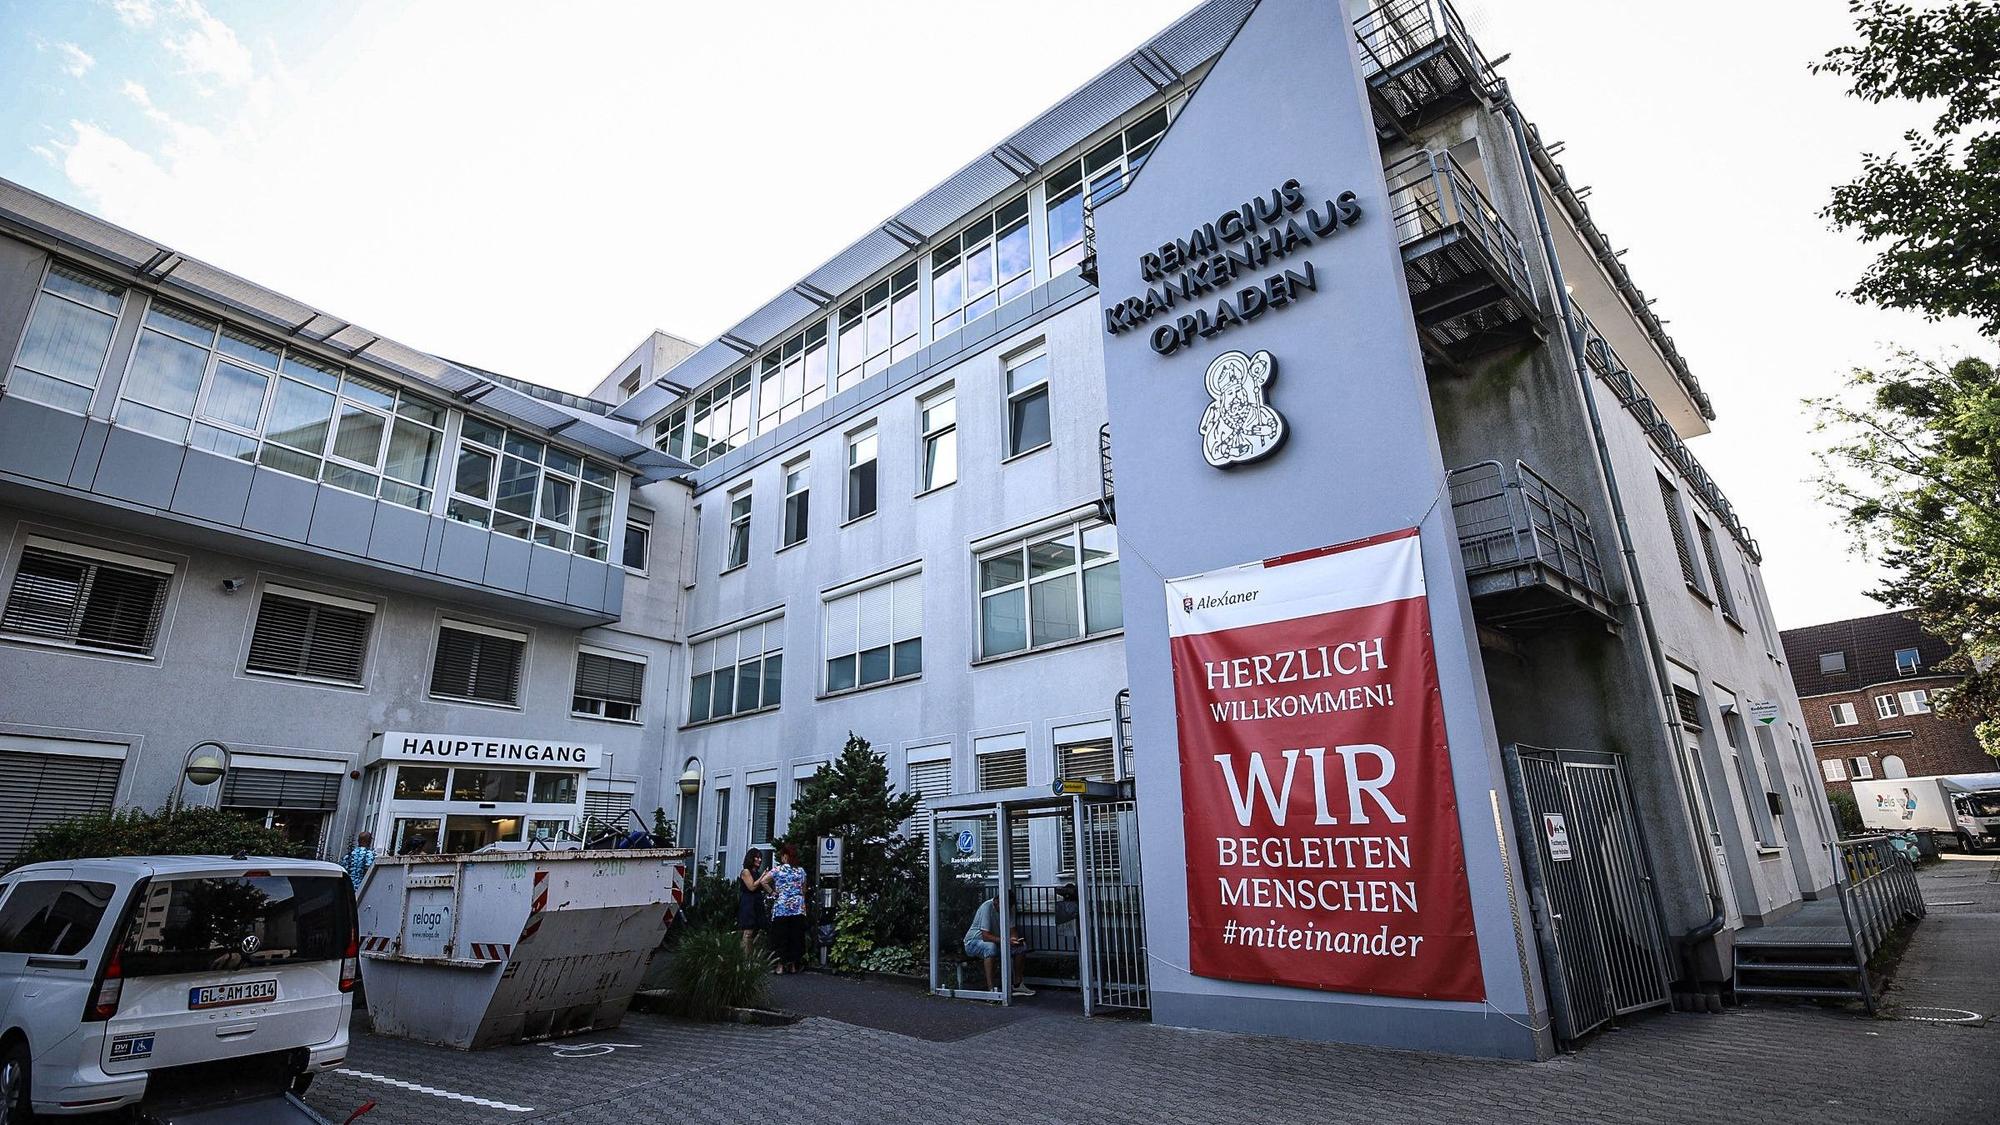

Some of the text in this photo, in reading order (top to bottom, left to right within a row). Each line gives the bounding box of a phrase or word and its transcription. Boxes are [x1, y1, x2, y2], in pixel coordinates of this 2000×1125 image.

[1139, 177, 1306, 283] REMIGIUS
[1105, 190, 1362, 335] KRANKENHAUS
[1149, 260, 1318, 356] OPLADEN
[1196, 590, 1259, 610] Alexianer
[1204, 636, 1388, 690] HERZLICH
[1209, 684, 1394, 723] WILLKOMMEN!
[402, 738, 587, 763] HAUPTEINGANG
[1214, 744, 1406, 828] WIR
[1216, 836, 1411, 869] BEGLEITEN
[1218, 877, 1419, 914] MENSCHEN
[412, 906, 442, 930] reloga
[1222, 919, 1424, 957] #miteinander
[200, 982, 275, 1003] GL AM 1814
